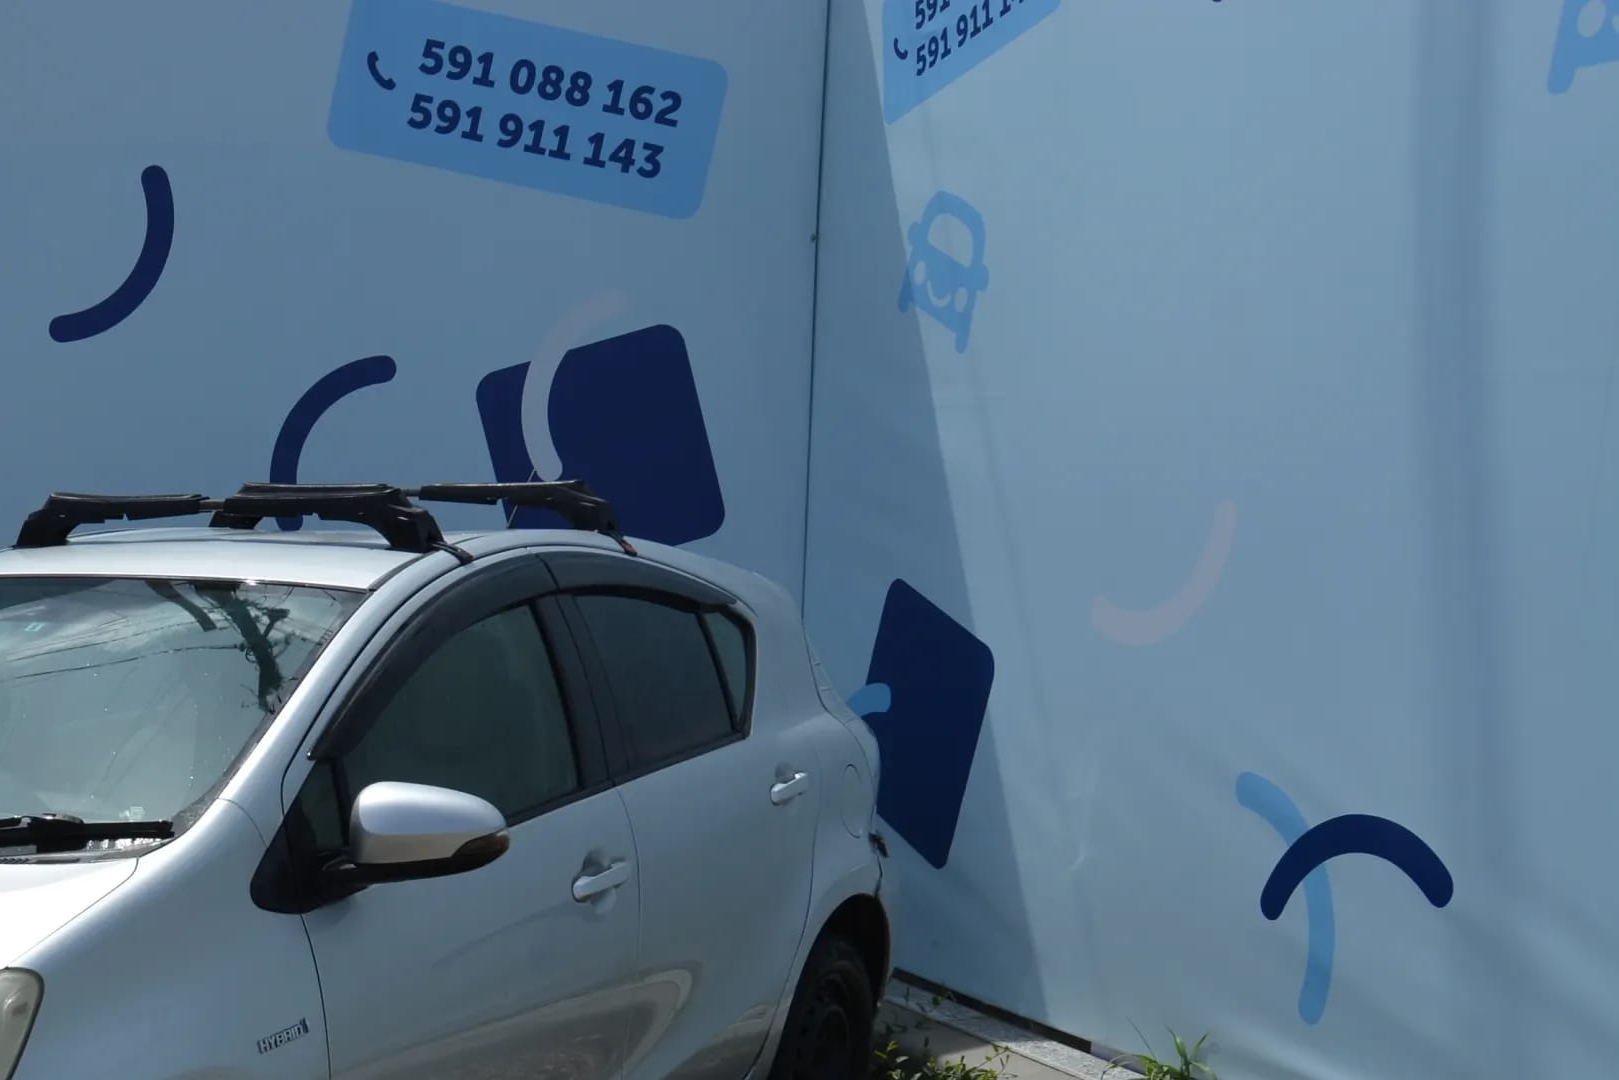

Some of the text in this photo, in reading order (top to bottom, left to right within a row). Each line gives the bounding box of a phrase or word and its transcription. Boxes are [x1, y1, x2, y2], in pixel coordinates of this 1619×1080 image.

[916, 0, 993, 76] 591 911
[418, 38, 683, 128] 591 088 162
[406, 93, 665, 179] 591 911 143
[260, 1023, 304, 1053] HYBRID
